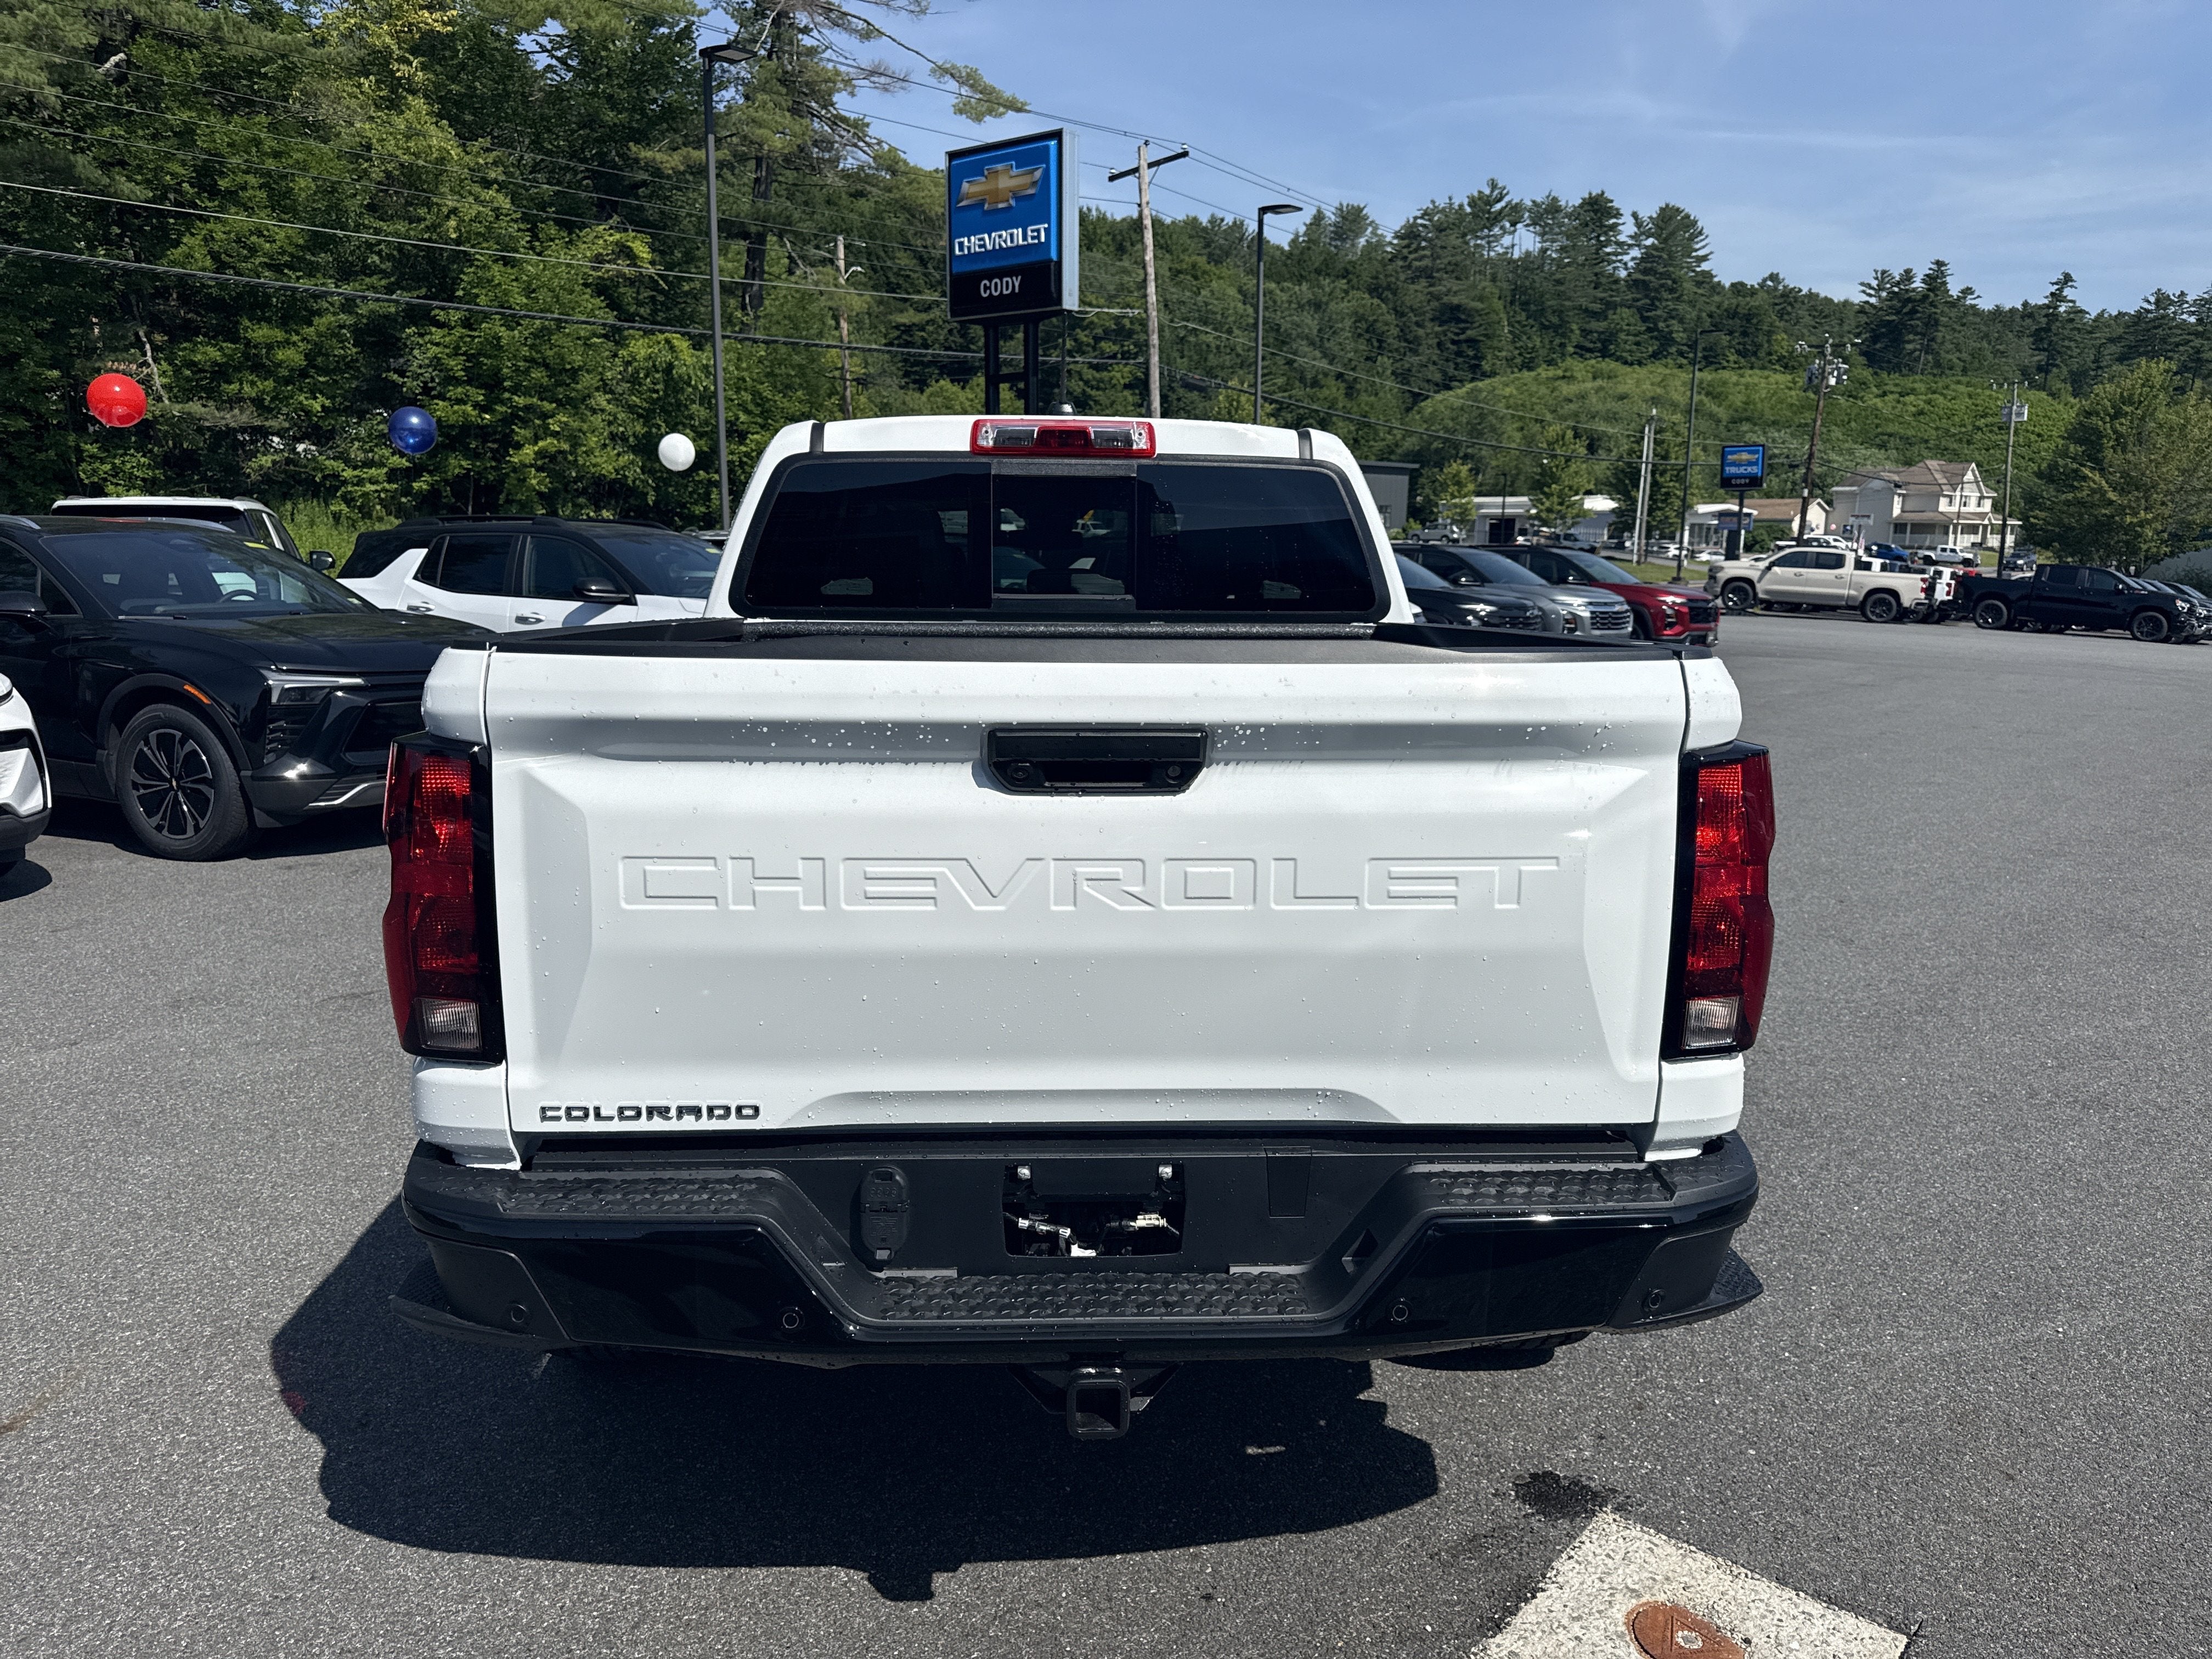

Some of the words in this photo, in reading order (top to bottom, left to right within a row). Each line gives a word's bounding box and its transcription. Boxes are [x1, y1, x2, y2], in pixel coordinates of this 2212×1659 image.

[954, 223, 1048, 256] CHEVROLET
[980, 275, 1022, 297] CODY
[1724, 465, 1758, 474] TRUCKS
[618, 856, 1560, 911] CHEVROLET
[539, 1103, 761, 1123] COLORADO
